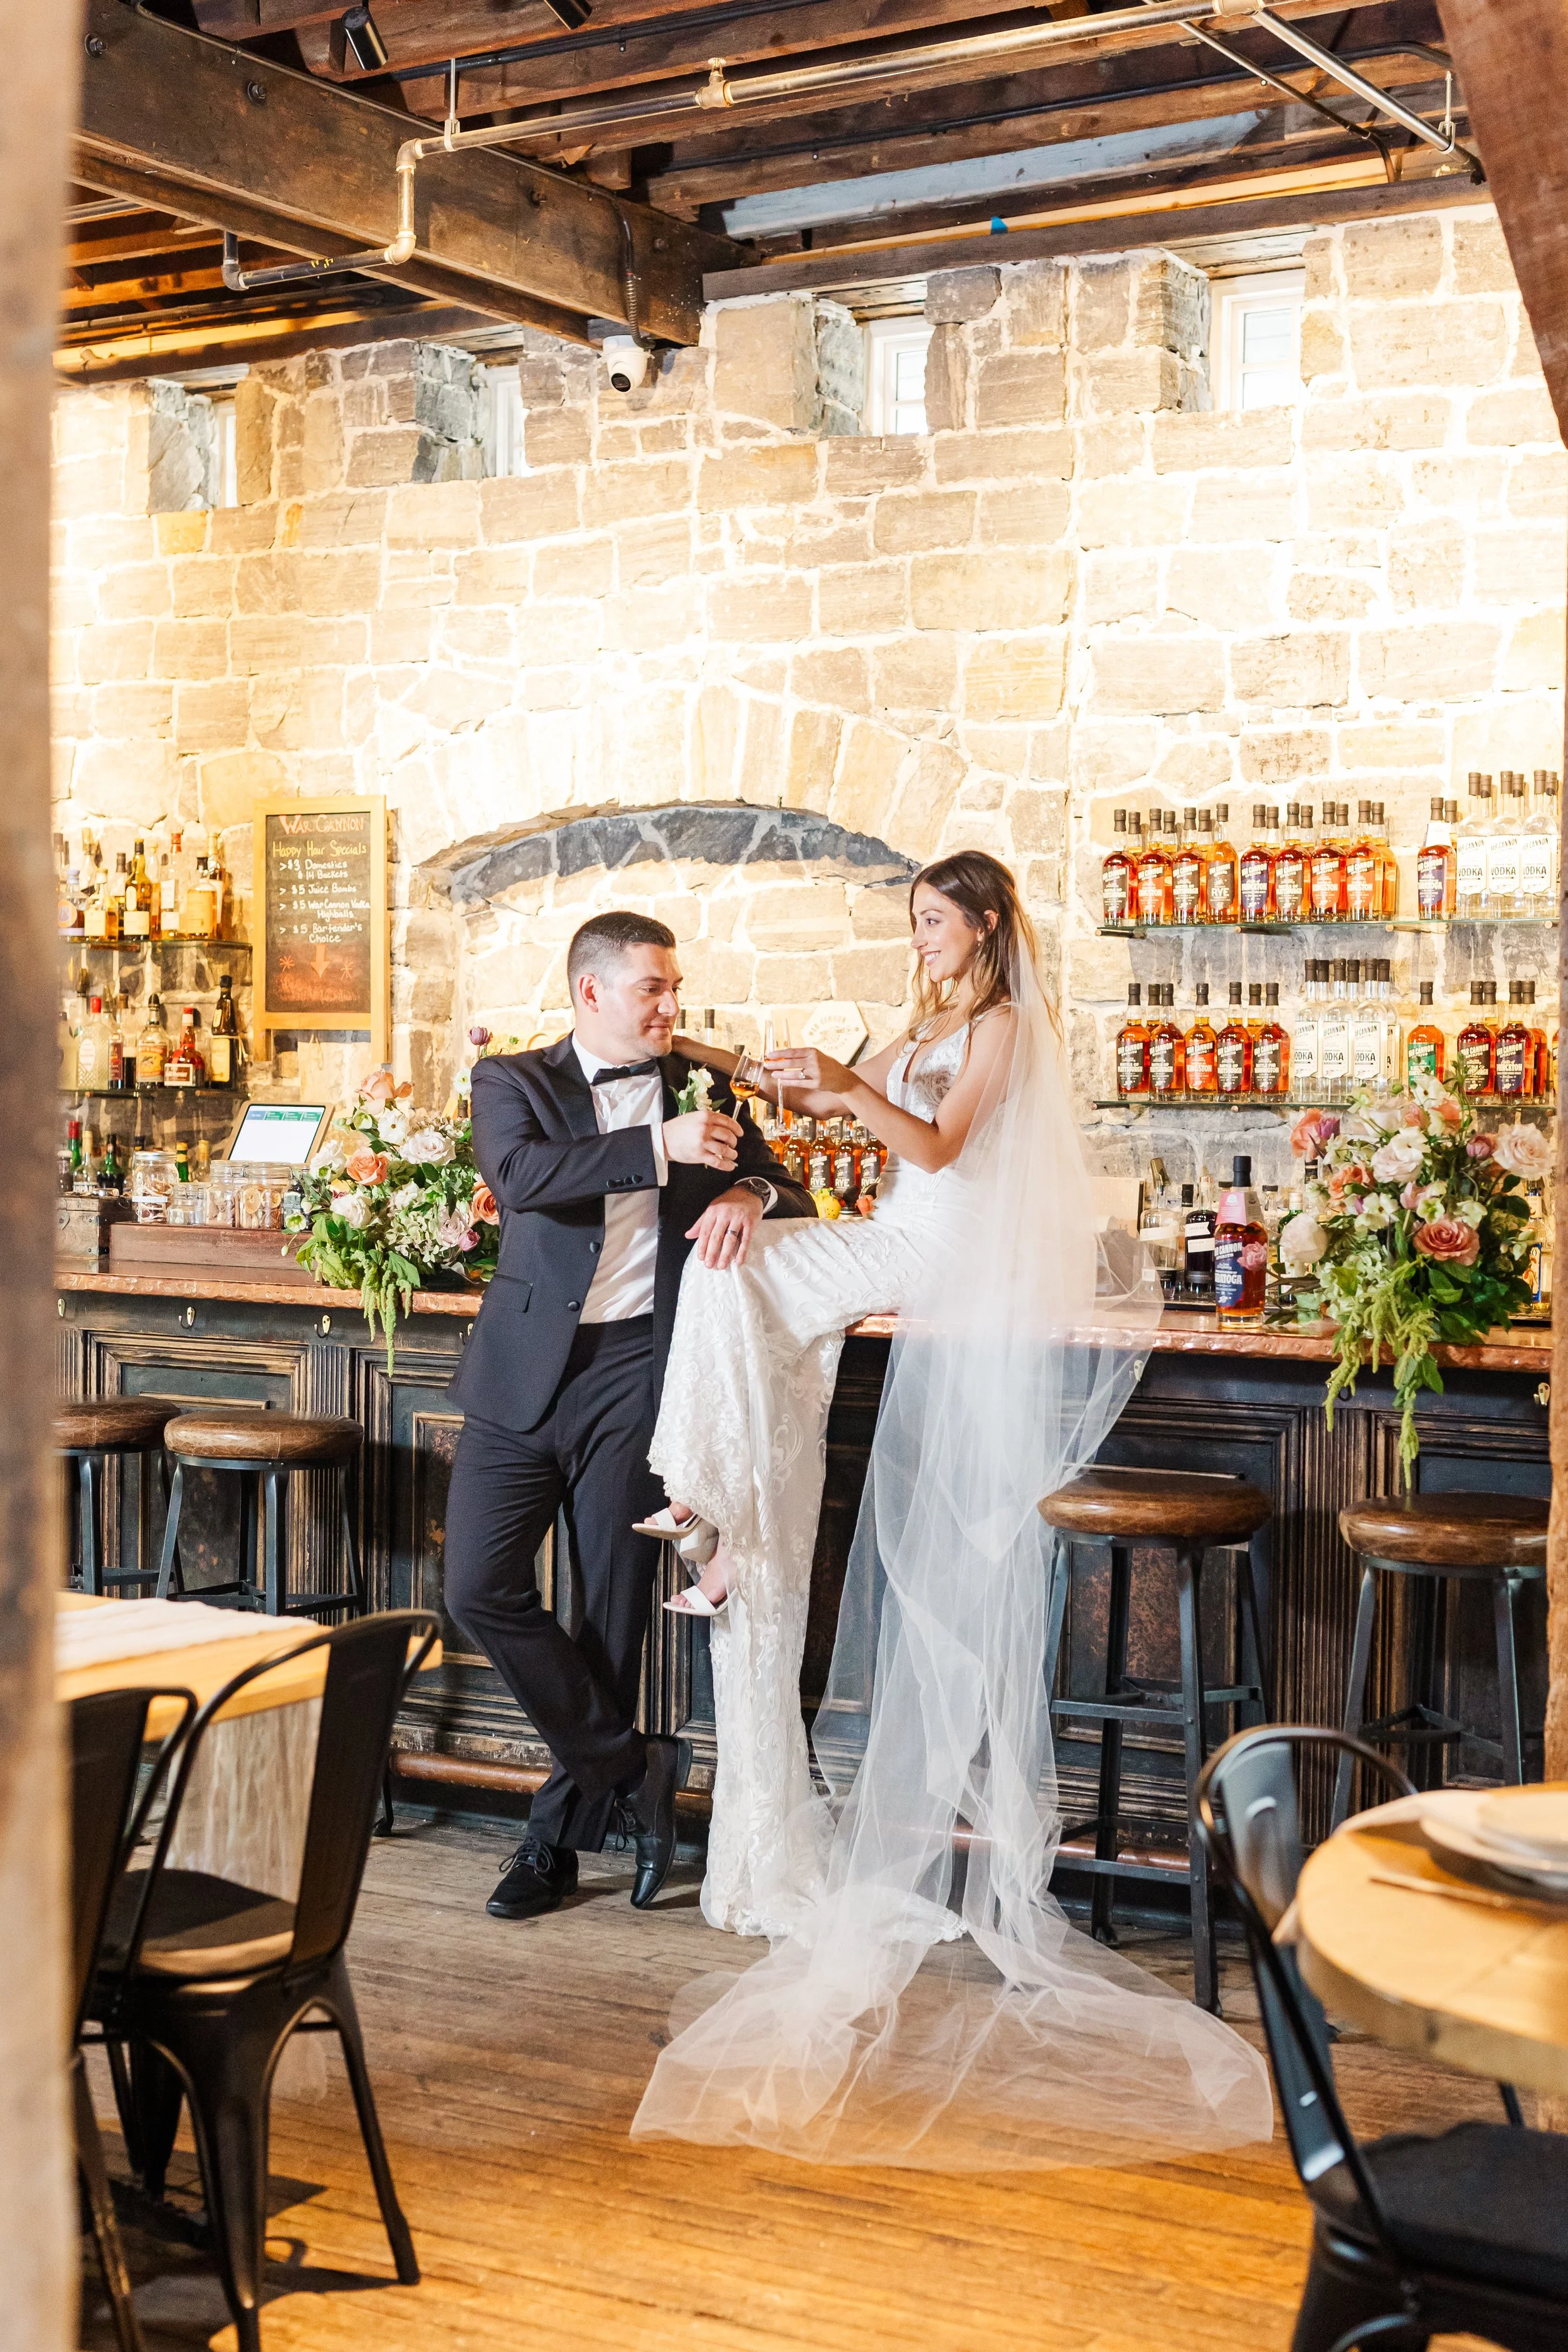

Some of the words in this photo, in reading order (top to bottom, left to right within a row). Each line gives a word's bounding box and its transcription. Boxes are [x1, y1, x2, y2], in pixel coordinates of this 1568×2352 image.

[279, 814, 312, 834] WAR
[316, 814, 364, 832] CANNON
[273, 841, 301, 857] Happy
[307, 840, 325, 857] Hour
[330, 840, 366, 857] Specials
[305, 859, 347, 870] Domestics
[317, 869, 348, 879] Buckets
[1458, 868, 1483, 876] VODKA
[1491, 867, 1515, 875] VODKA
[308, 884, 329, 894] Juice
[332, 882, 357, 893] Bombs
[1212, 887, 1229, 896] RYE
[324, 898, 349, 909] Cannon
[351, 899, 371, 909] Vodka
[317, 909, 354, 923] Highballs
[312, 922, 363, 933] Bartender's
[309, 933, 341, 943] Choice
[1298, 1024, 1314, 1034] CANNON
[1328, 1025, 1345, 1036] CANNON
[1359, 1025, 1377, 1036] CANNON
[1470, 1044, 1488, 1054] CANNON
[1503, 1043, 1522, 1054] CANNON
[1295, 1052, 1312, 1060] ODKA
[810, 1178, 825, 1186] RYE
[835, 1179, 850, 1187] RYE
[1219, 1242, 1242, 1255] CANNON
